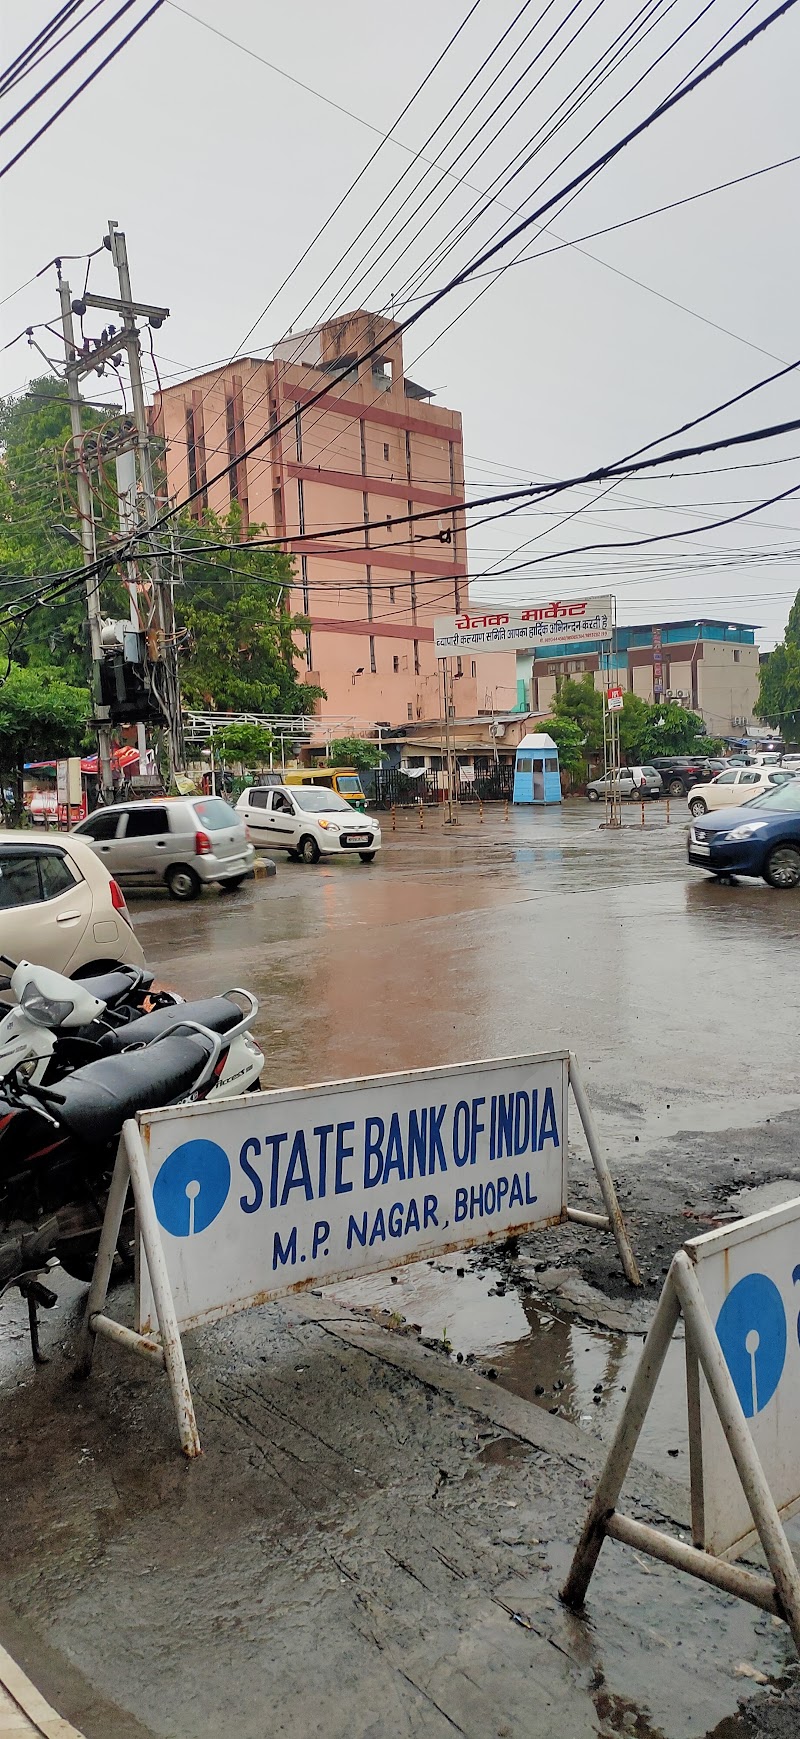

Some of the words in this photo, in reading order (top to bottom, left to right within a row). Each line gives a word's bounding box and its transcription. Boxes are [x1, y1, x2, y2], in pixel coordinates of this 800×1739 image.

[455, 613, 509, 630] चेतक
[521, 601, 588, 621] मार्केट
[460, 633, 485, 645] कल्याण
[486, 627, 506, 641] समिति
[508, 627, 528, 639] आपका
[529, 621, 549, 638] हार्दिक
[582, 615, 601, 630] करती
[602, 614, 608, 629] है
[240, 1121, 355, 1214] STATE
[363, 1104, 448, 1189] BANK
[452, 1097, 486, 1168] OF
[490, 1087, 560, 1161] INDIA
[454, 1171, 538, 1223] BHOPAL
